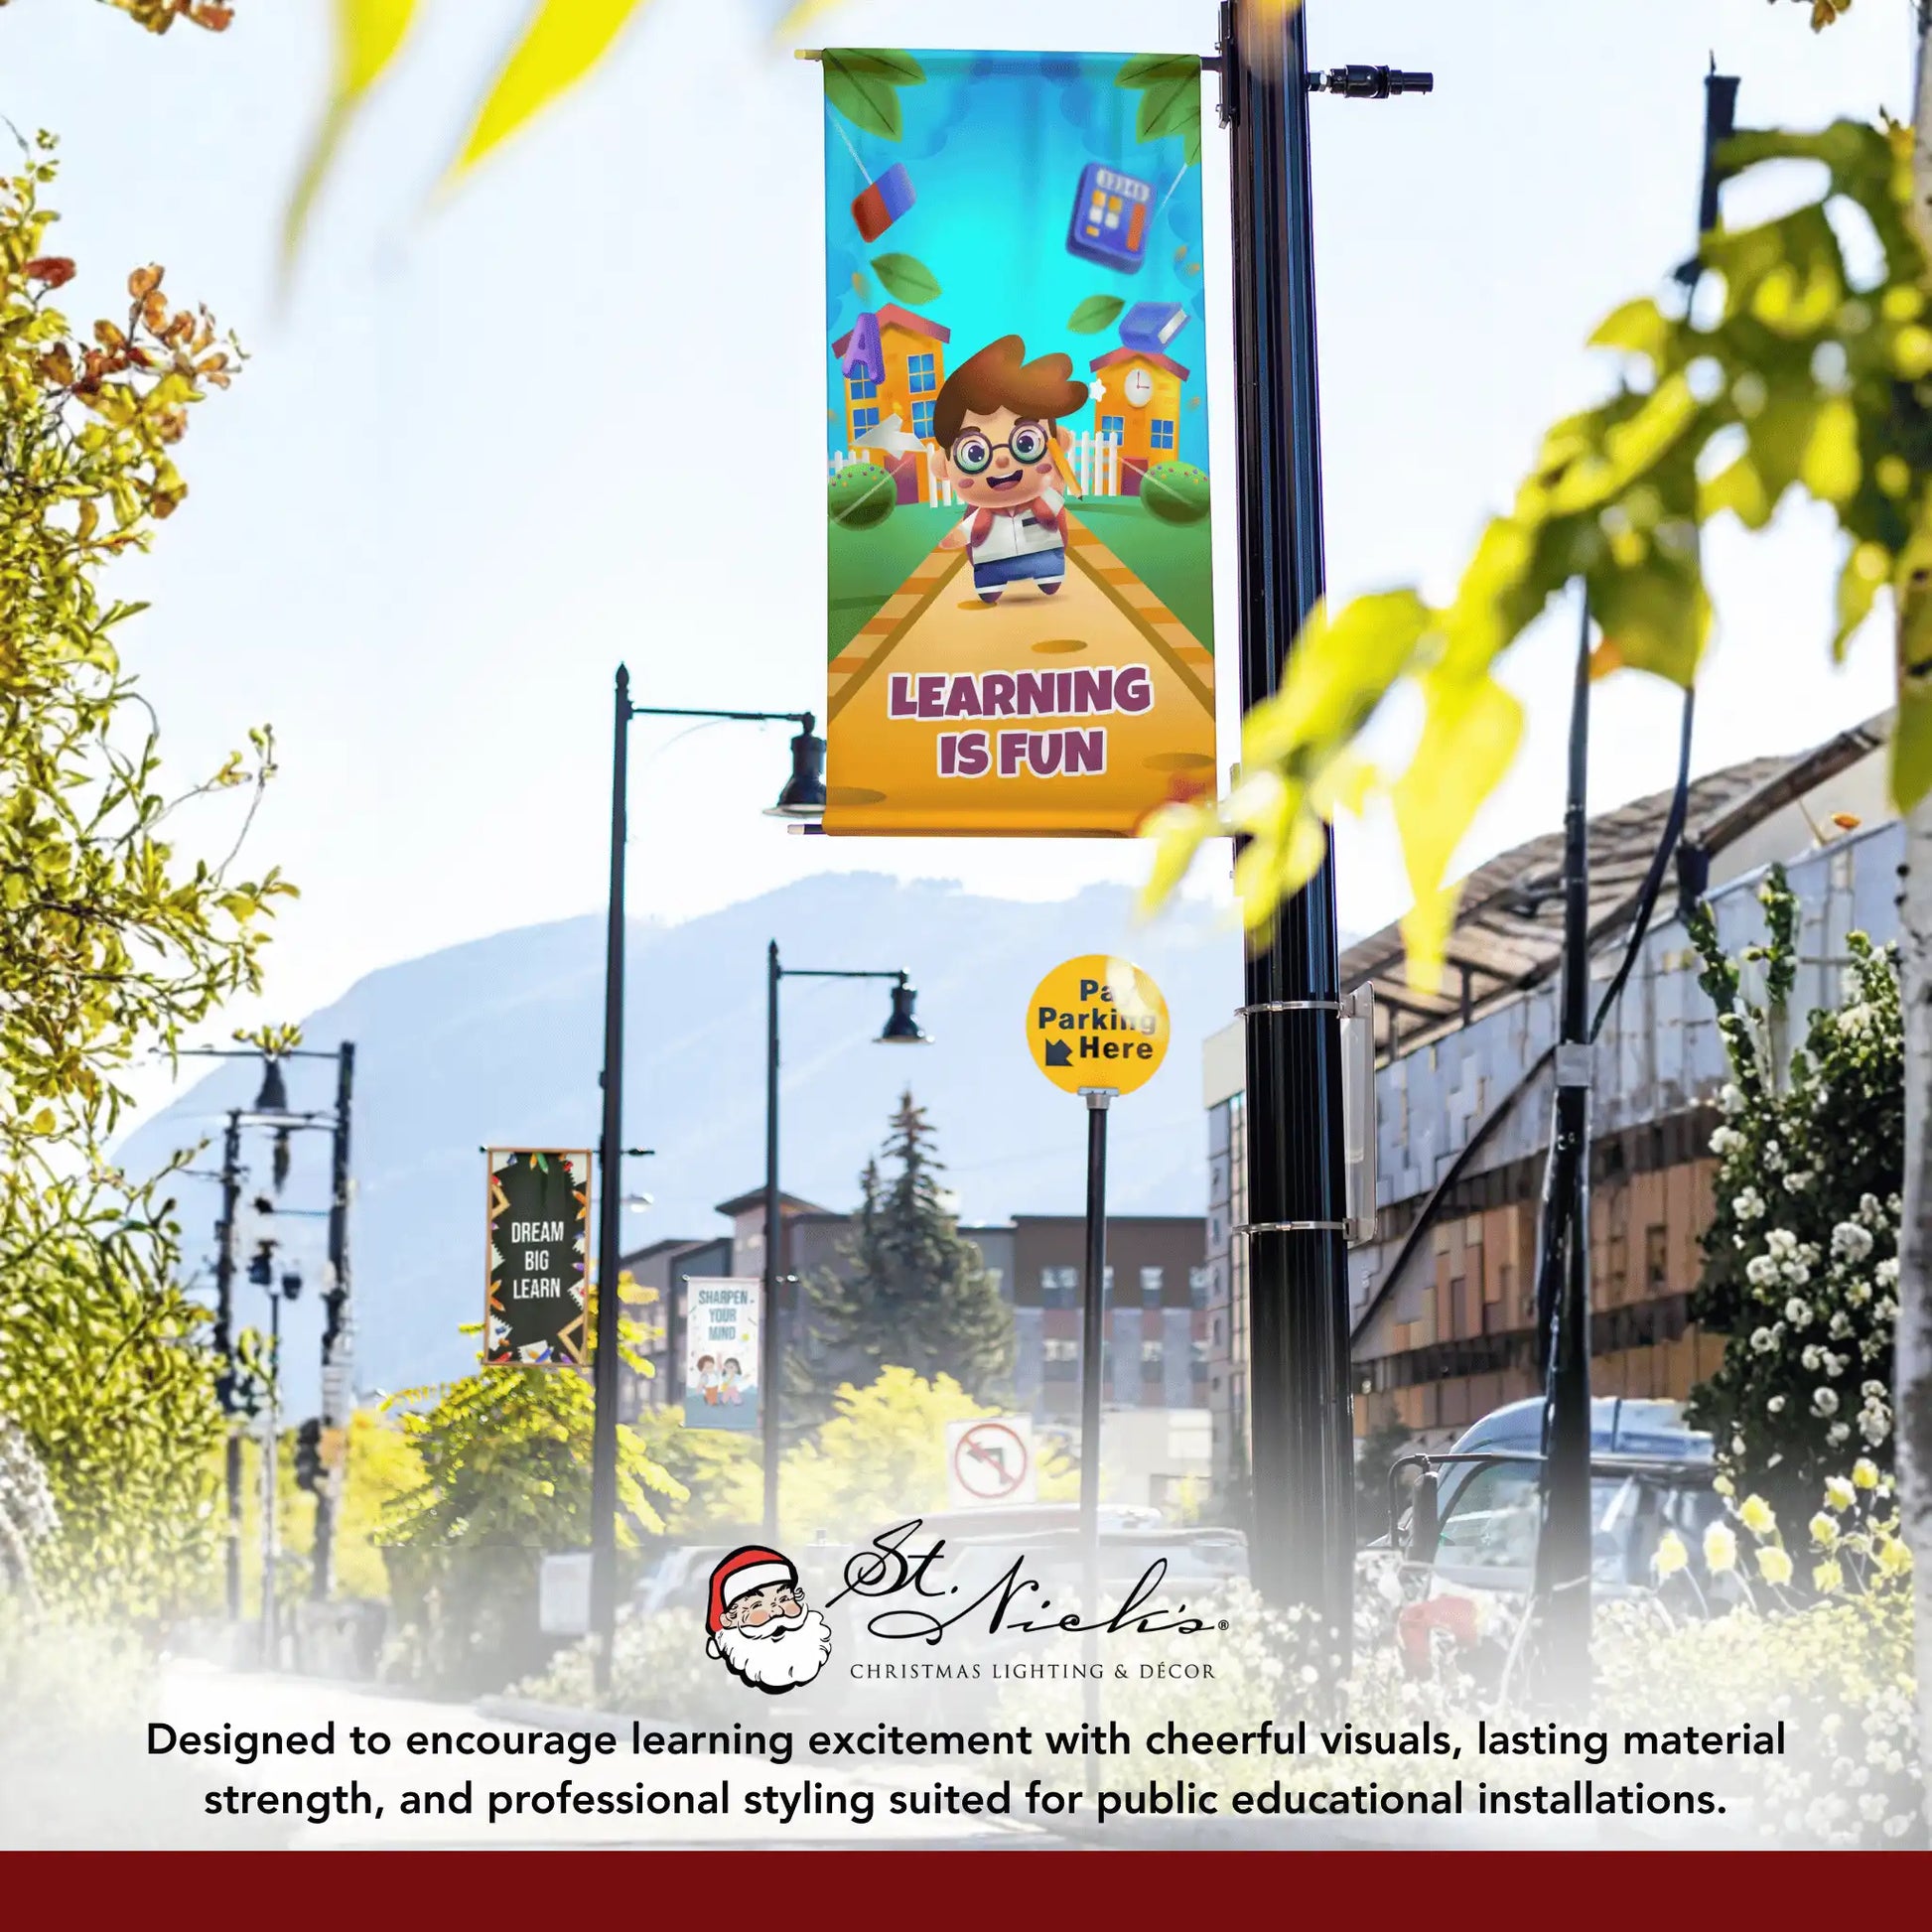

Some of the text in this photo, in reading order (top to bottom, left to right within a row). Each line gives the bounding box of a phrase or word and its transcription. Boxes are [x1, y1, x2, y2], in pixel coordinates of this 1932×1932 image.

[842, 313, 886, 384] A
[890, 665, 1152, 719] LEARNING
[938, 729, 1105, 776] IS FUN
[1080, 979, 1129, 1005] Pa
[1080, 1035, 1154, 1059] Here
[511, 1221, 564, 1243] DREAM
[524, 1249, 549, 1271] BIG
[512, 1278, 561, 1300] LEARN
[698, 1290, 749, 1306] SHARPEN
[709, 1308, 737, 1323] YOUR
[708, 1326, 736, 1340] MIND
